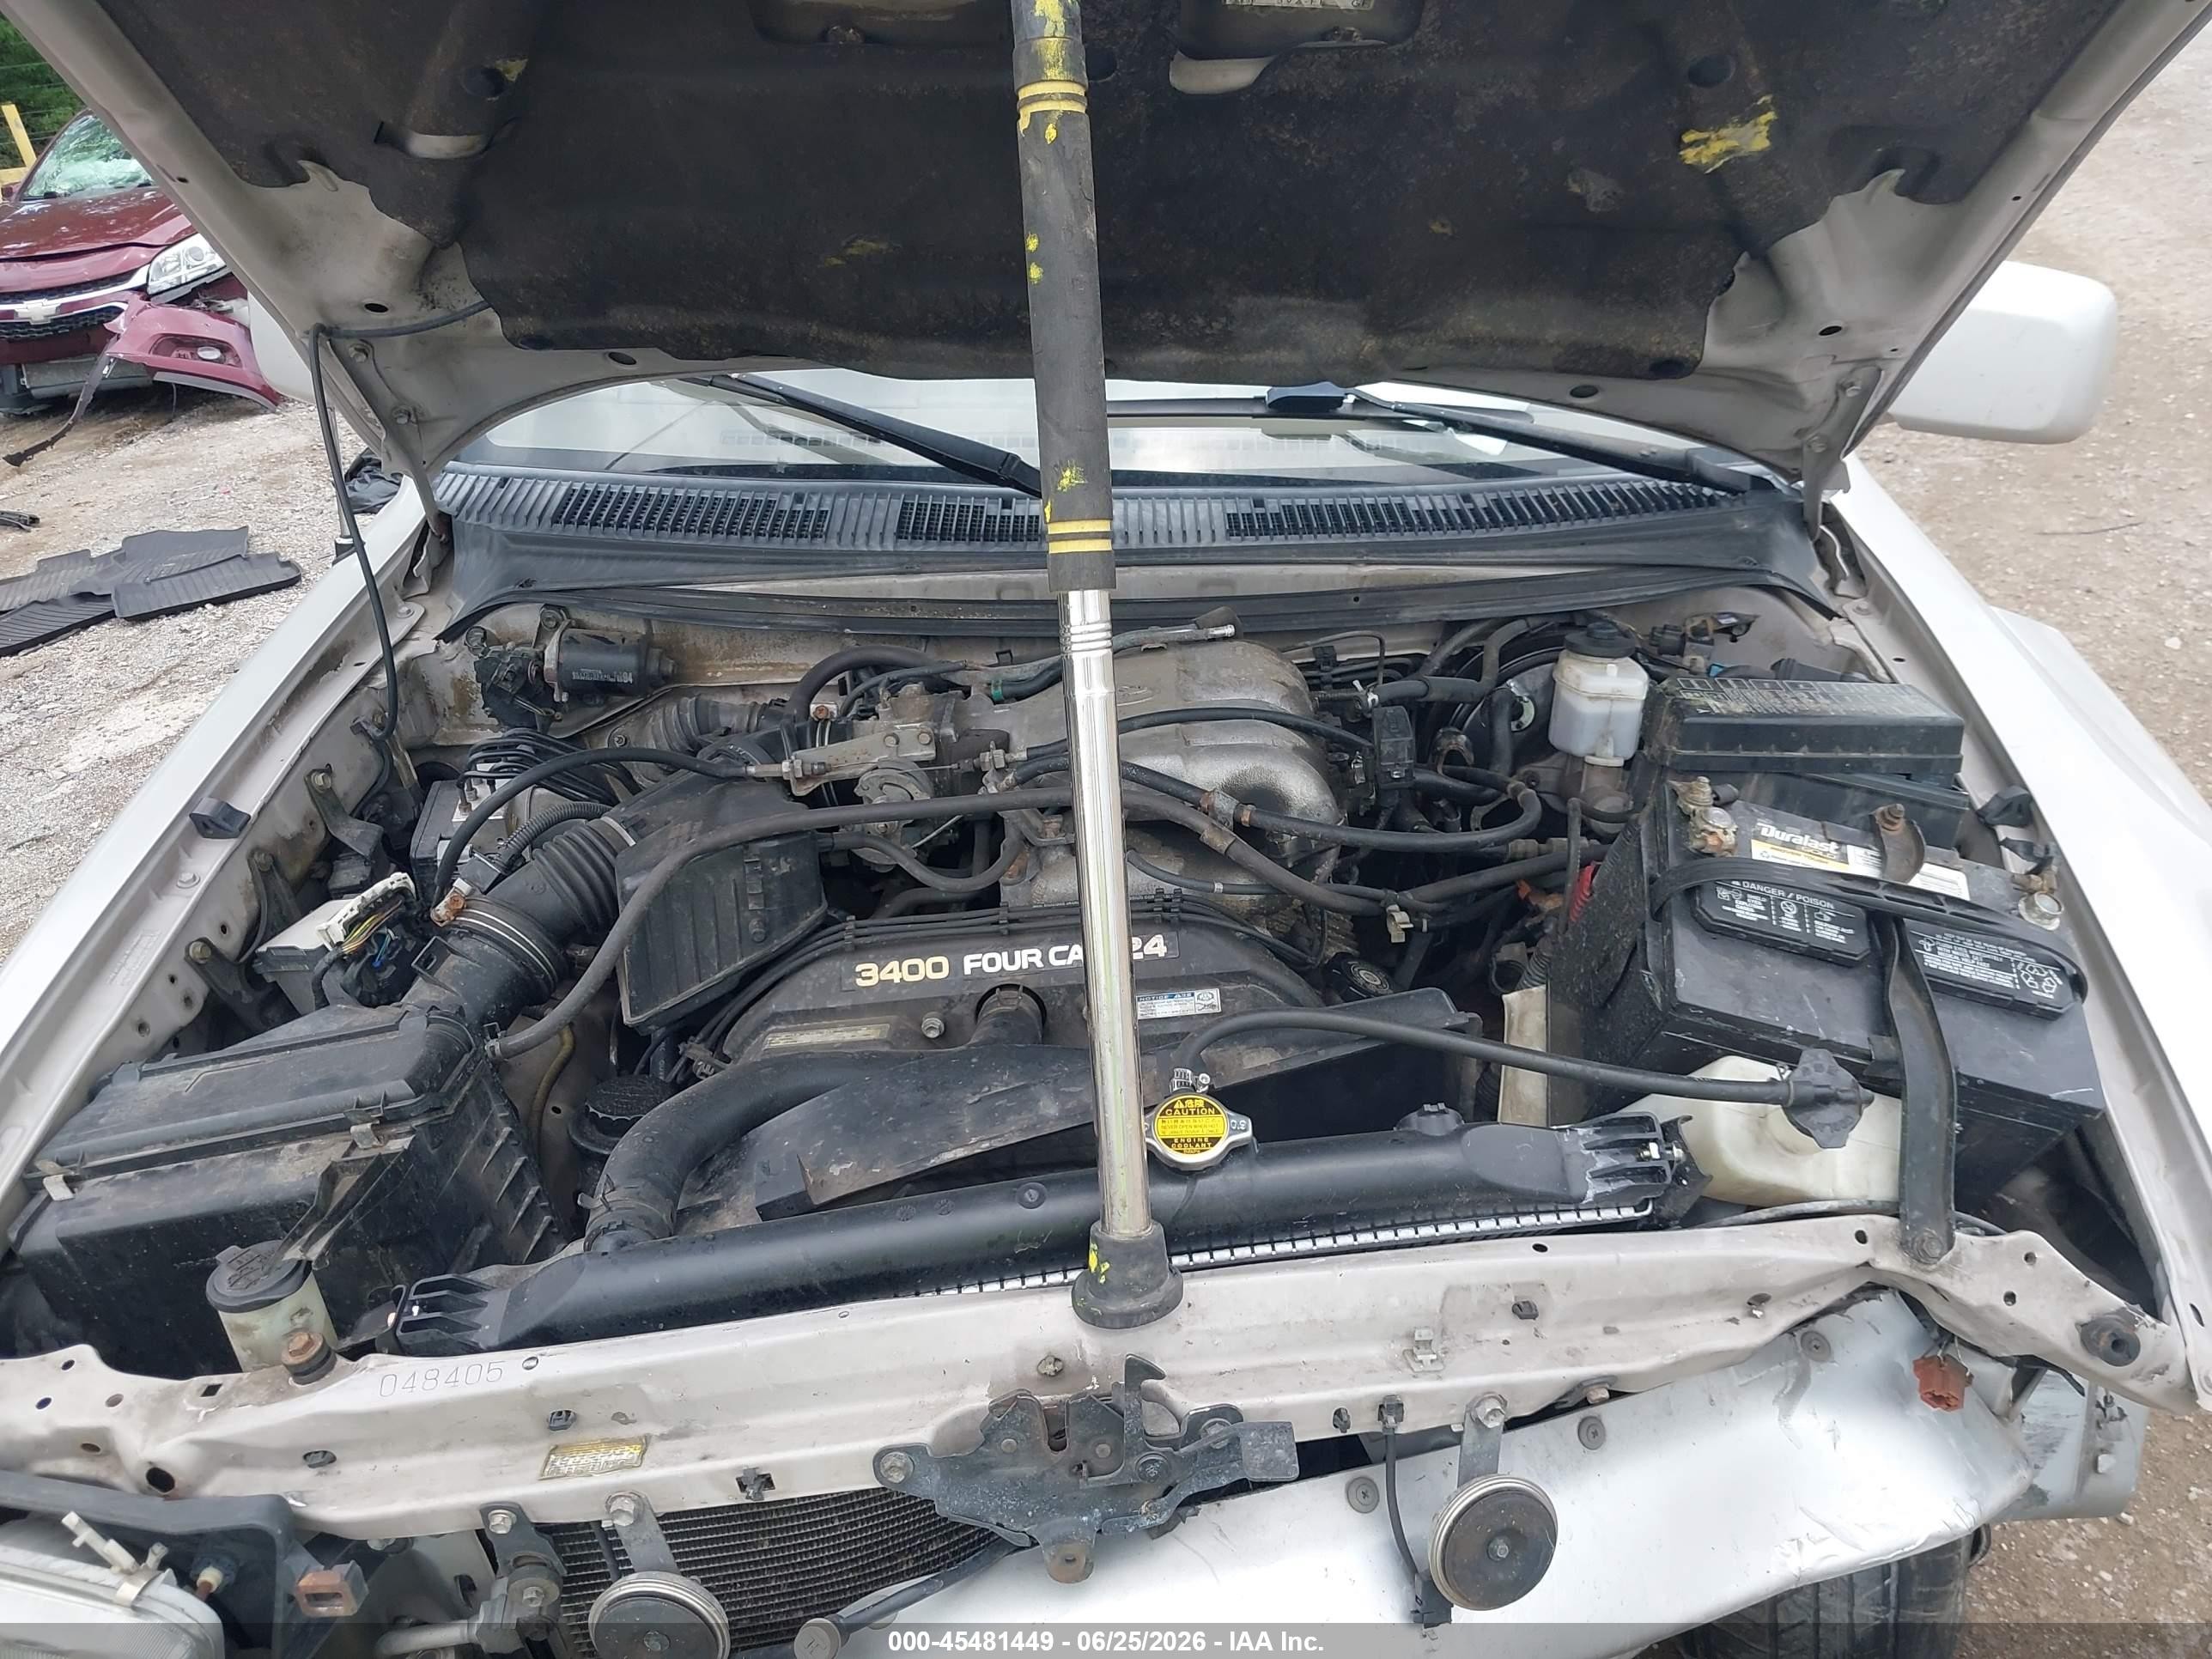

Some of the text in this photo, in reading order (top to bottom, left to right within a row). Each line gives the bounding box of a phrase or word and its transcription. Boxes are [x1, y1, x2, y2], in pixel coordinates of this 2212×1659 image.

[1757, 823, 1839, 854] Duralast
[1742, 881, 1785, 897] DANGER
[1796, 894, 1835, 909] POISON
[855, 956, 950, 987] 3400
[963, 948, 1042, 975] FOUR
[1048, 944, 1084, 967] CA
[380, 1361, 507, 1397] 048405
